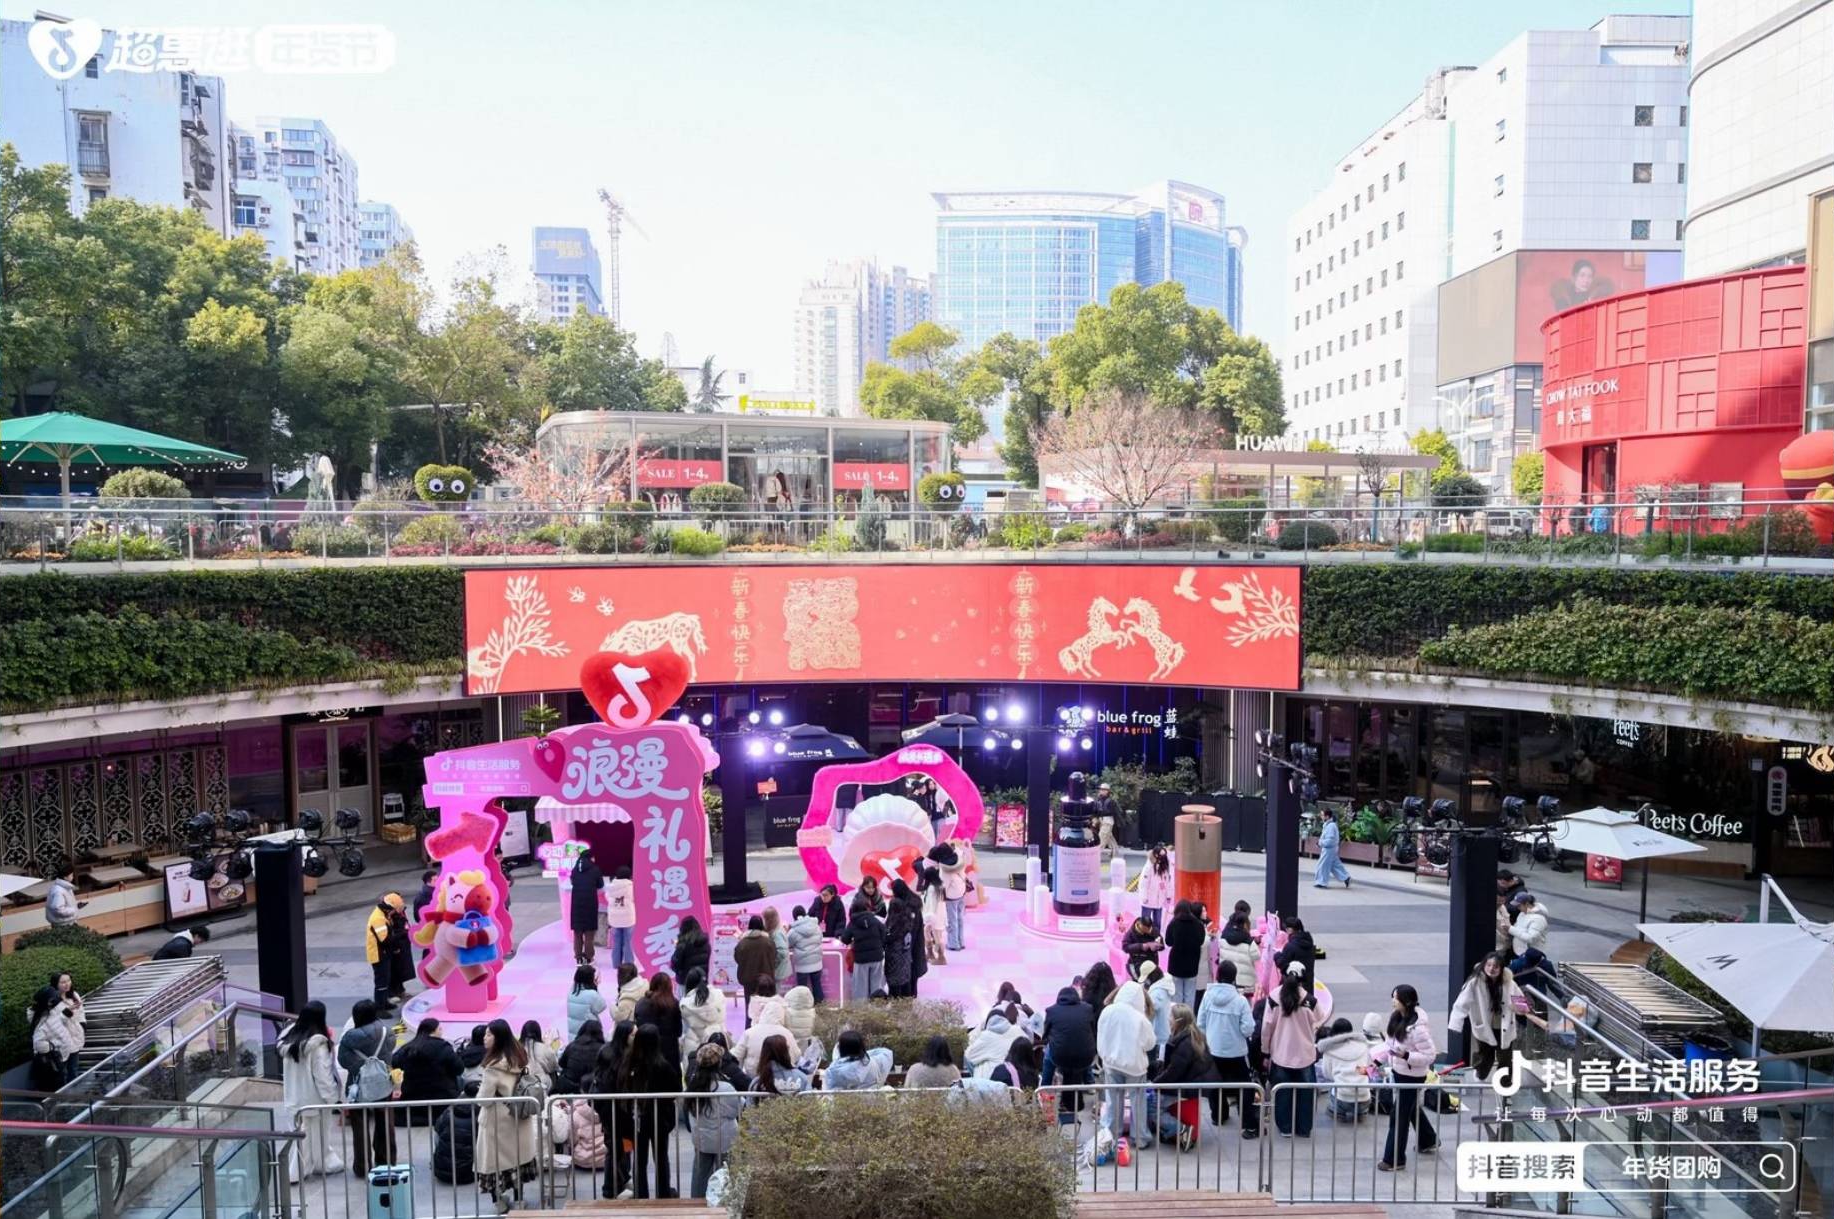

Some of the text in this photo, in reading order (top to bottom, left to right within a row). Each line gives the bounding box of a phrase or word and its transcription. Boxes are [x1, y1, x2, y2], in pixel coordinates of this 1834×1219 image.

[1585, 379, 1619, 395] FOOK
[647, 468, 675, 479] SALE
[730, 577, 750, 663] 新春快乐
[1014, 575, 1034, 664] 新春快乐
[1097, 710, 1161, 727] blue frog
[1613, 719, 1640, 740] Peet's
[1616, 739, 1634, 748] COFFEE
[455, 758, 520, 771] 抖音生活服务
[562, 737, 689, 799] 浪漫
[1690, 813, 1743, 837] Coffee
